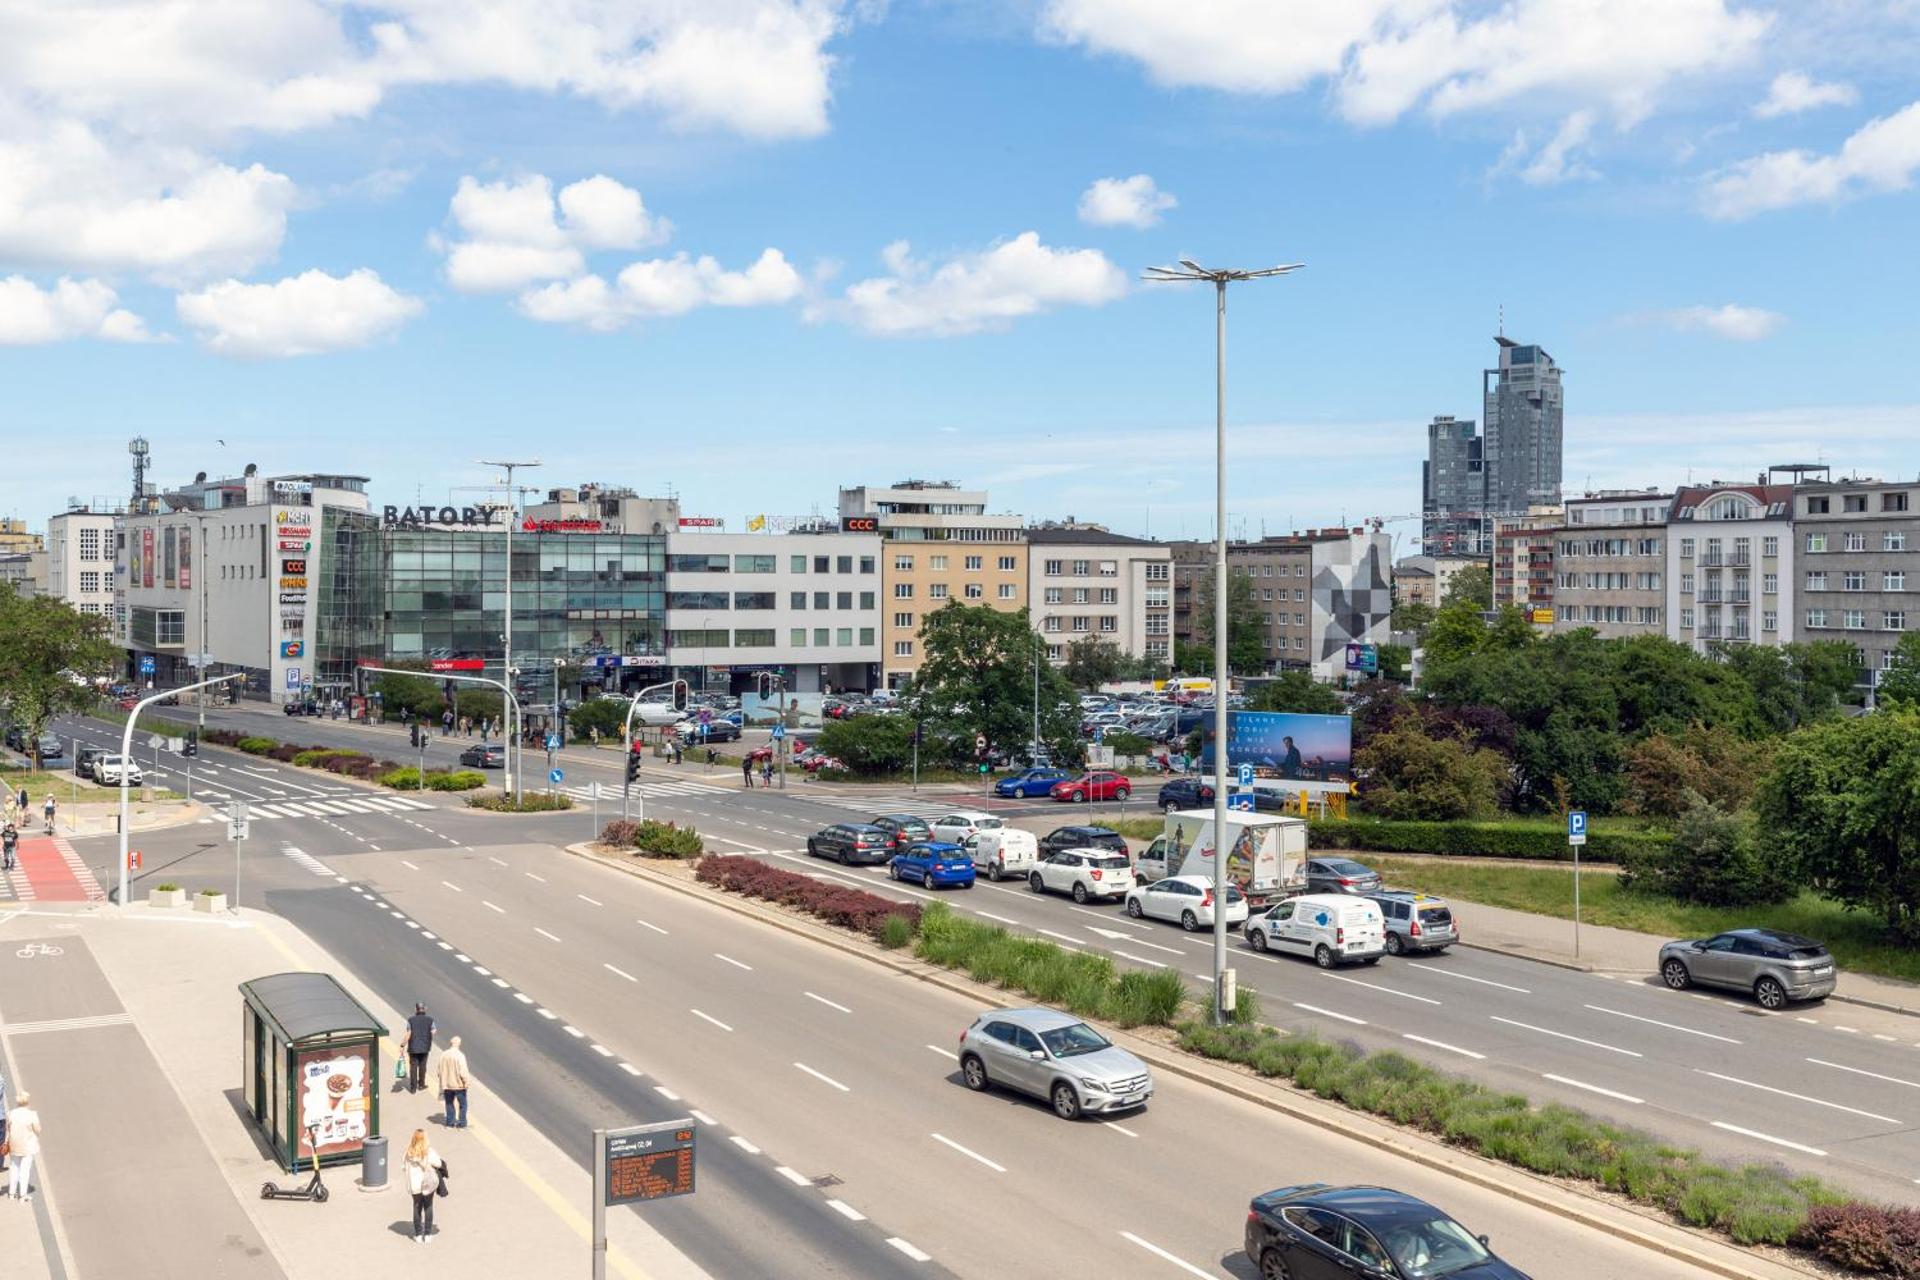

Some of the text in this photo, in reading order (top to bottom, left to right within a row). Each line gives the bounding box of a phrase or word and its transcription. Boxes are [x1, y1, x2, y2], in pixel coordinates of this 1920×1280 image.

[383, 504, 497, 527] BATORY
[687, 518, 714, 526] SPAR
[848, 519, 874, 530] CCC
[287, 561, 305, 572] CCC
[640, 658, 660, 666] ITAKA
[1242, 769, 1250, 782] P
[1572, 814, 1583, 833] P
